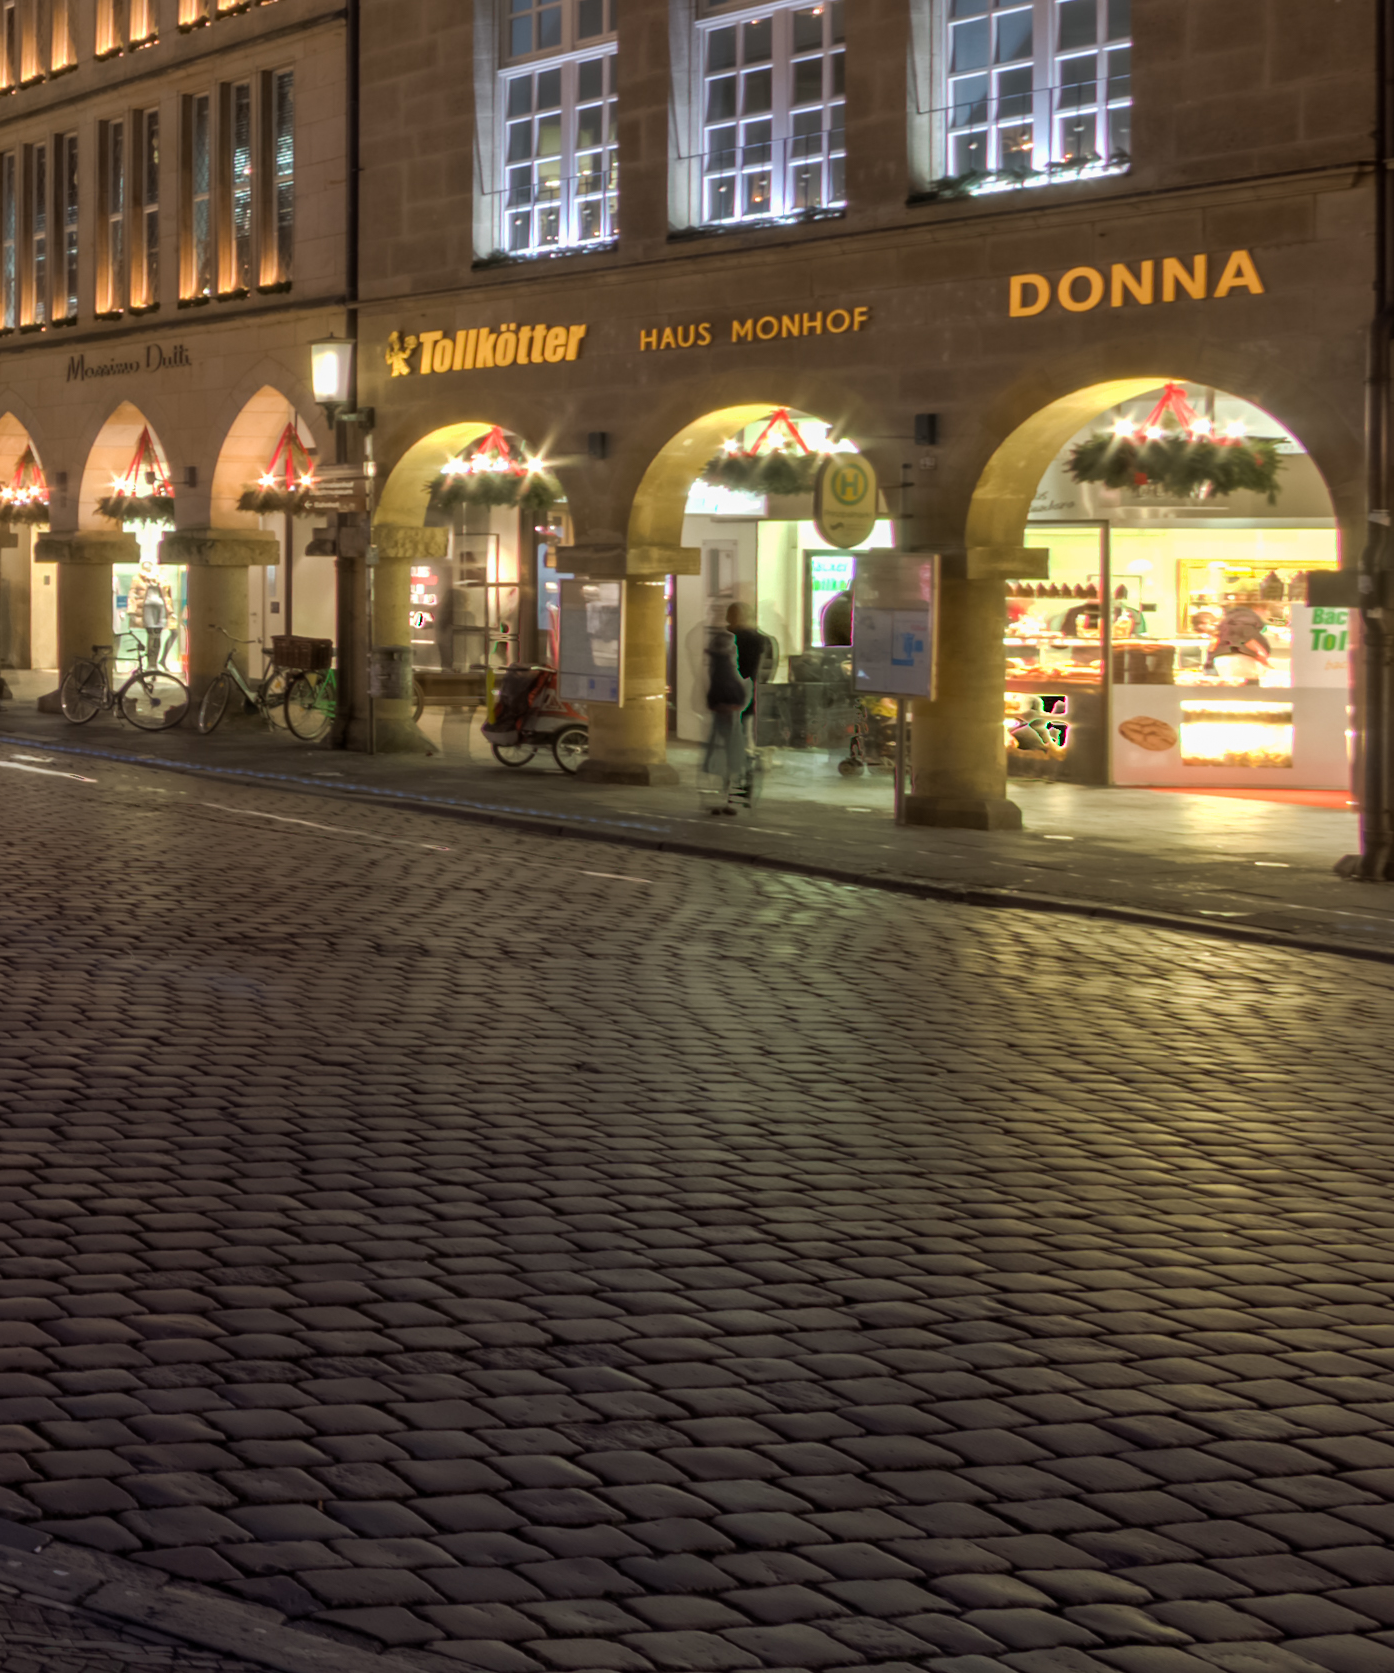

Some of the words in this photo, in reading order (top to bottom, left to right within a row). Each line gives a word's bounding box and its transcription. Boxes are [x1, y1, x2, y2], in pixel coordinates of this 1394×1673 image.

[1008, 249, 1265, 318] DONNA
[419, 322, 586, 375] Tollkötter
[639, 322, 711, 351] HAUS
[731, 306, 869, 343] MONHOF
[66, 353, 140, 382] Massimo
[145, 343, 192, 373] Dutti
